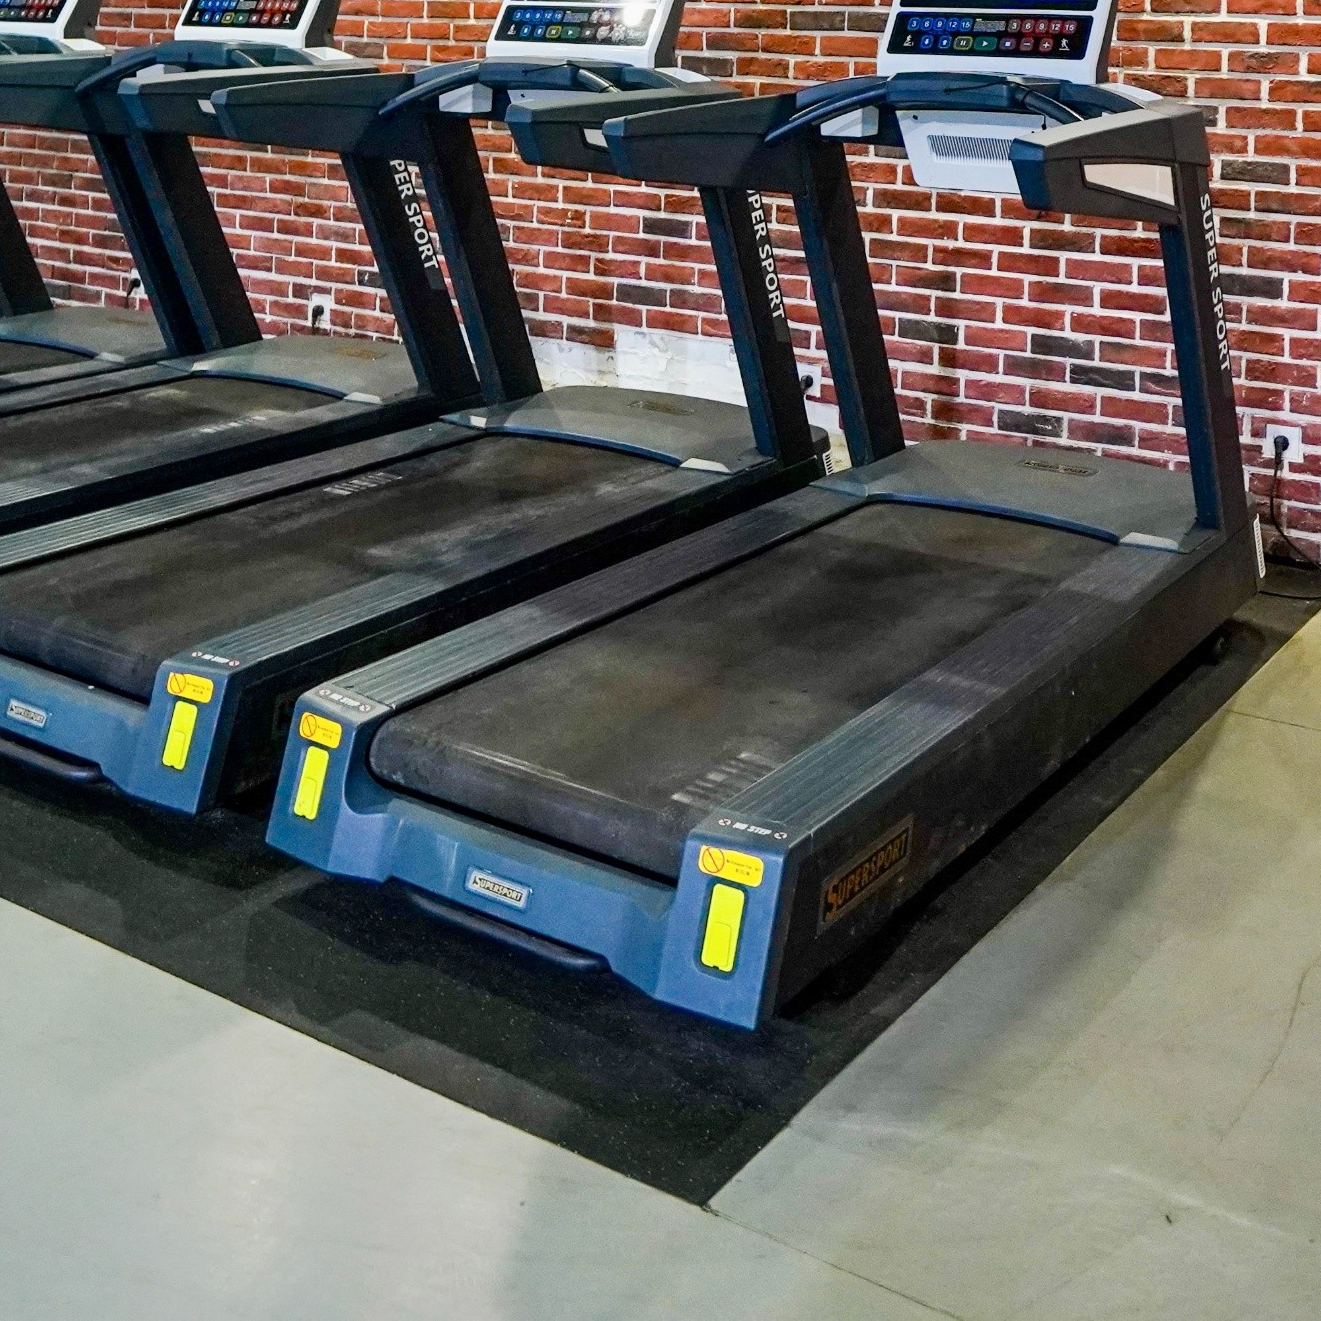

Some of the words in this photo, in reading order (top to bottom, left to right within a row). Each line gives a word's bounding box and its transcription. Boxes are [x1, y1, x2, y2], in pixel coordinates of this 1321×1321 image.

[389, 159, 414, 199] PER
[405, 202, 439, 269] SPORT
[747, 190, 767, 240] PER
[759, 244, 785, 318] SPORT
[1200, 193, 1220, 283] SUPER
[1212, 287, 1231, 371] SPORT
[473, 876, 522, 901] SUPERSPORT
